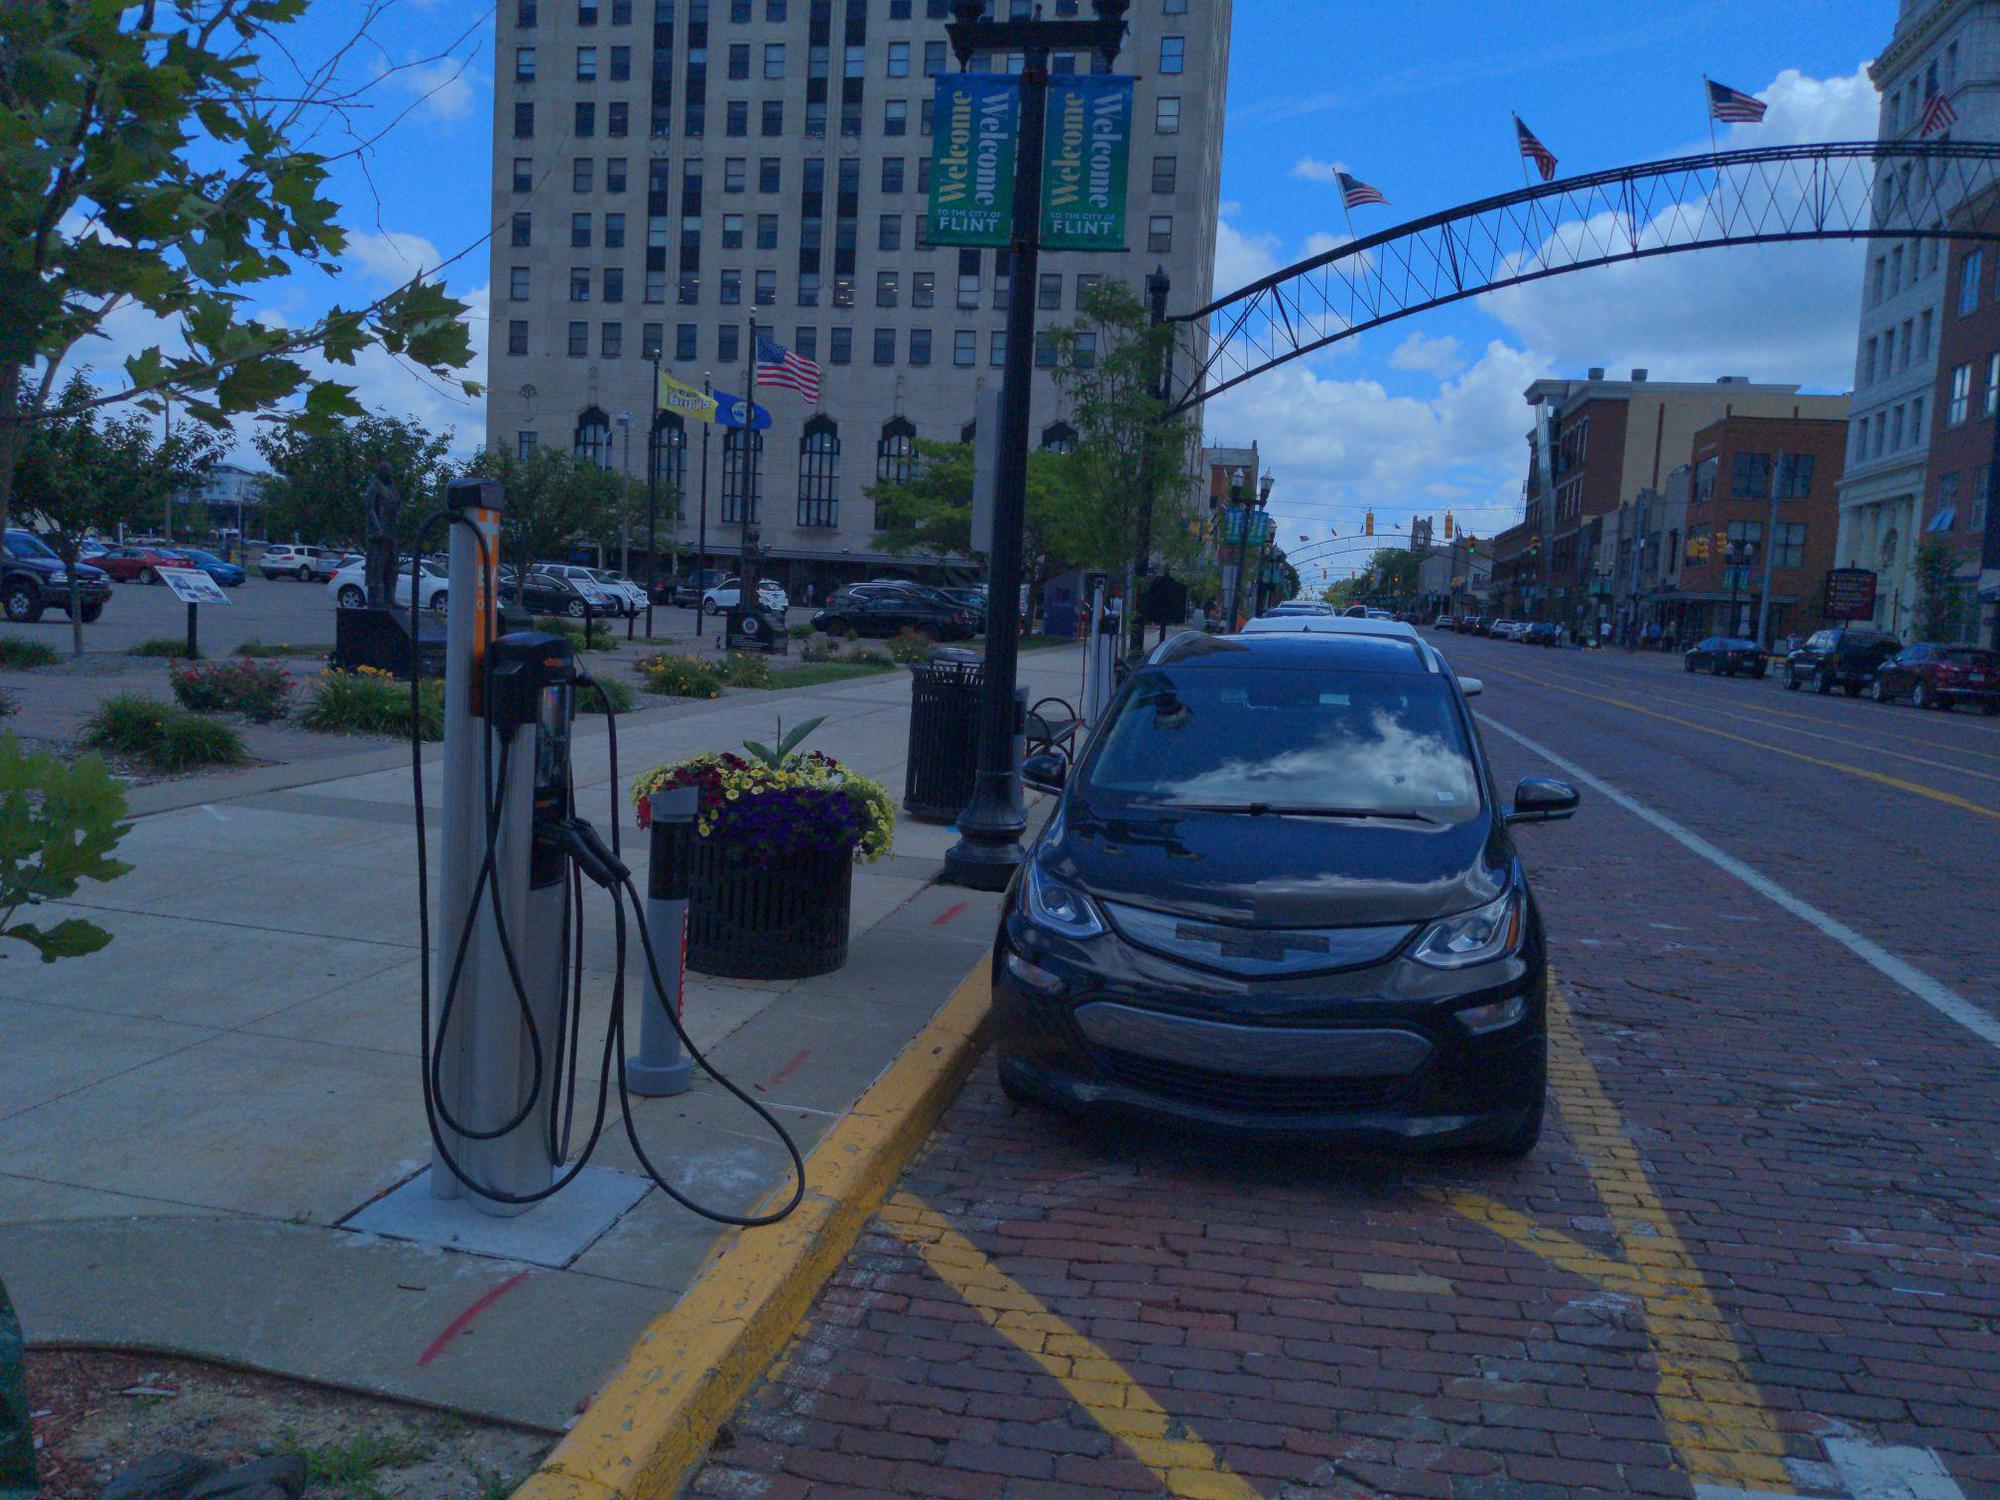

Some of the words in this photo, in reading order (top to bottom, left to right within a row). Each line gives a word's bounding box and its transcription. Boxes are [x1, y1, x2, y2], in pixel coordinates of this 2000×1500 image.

[938, 90, 972, 203] Welcome
[975, 92, 1010, 206] Welcome
[1051, 91, 1086, 206] Welcome
[1088, 92, 1123, 208] Welcome
[940, 217, 998, 232] FLINT
[969, 210, 988, 218] CITY
[1053, 220, 1112, 235] FLINT
